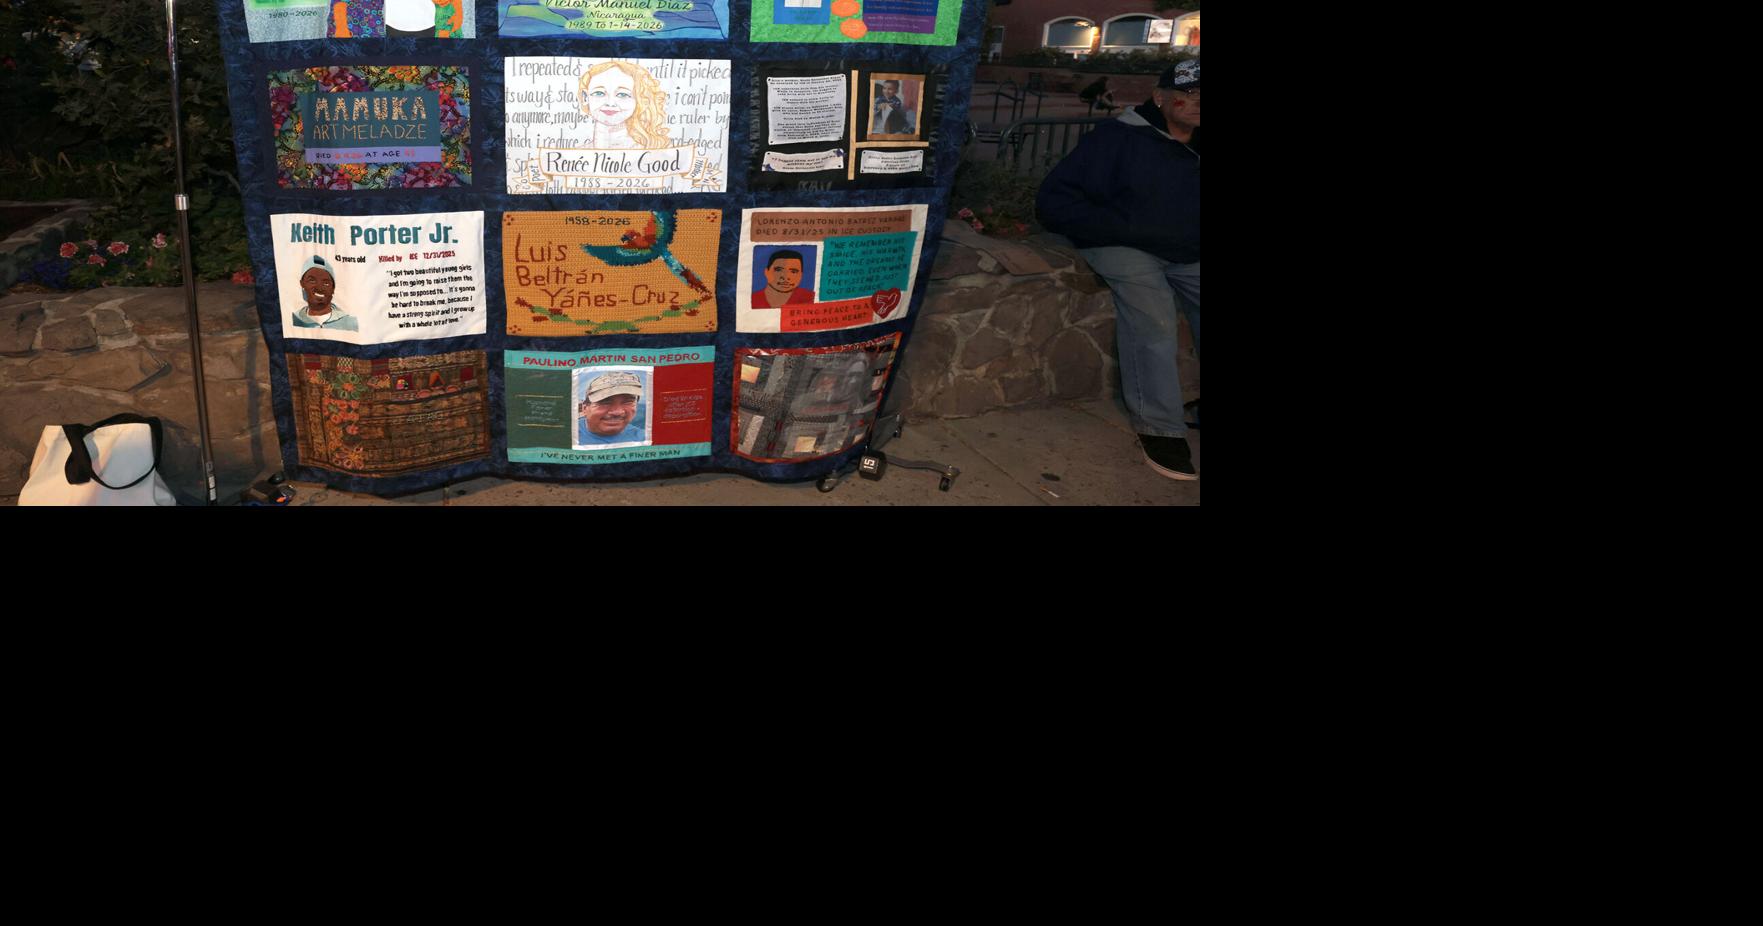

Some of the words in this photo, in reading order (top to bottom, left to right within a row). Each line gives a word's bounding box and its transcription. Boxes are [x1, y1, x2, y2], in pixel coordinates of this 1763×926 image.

[593, 0, 651, 9] Manuel
[587, 11, 646, 21] Nicaragua
[568, 20, 593, 29] 1989
[609, 20, 663, 30] 1-14-2026
[519, 57, 572, 84] repeated
[677, 58, 688, 78] it
[517, 90, 543, 108] way
[314, 96, 427, 122] MAMUKA
[679, 108, 711, 125] ruler
[382, 150, 401, 158] AGE
[546, 151, 590, 173] Renée
[593, 152, 632, 173] Nicole
[637, 149, 680, 174] Good
[616, 178, 650, 188] 2026
[757, 218, 800, 226] LORENZO
[801, 217, 844, 225] ANTONIO
[290, 223, 336, 245] Keith
[350, 223, 422, 246] Porter
[428, 222, 459, 244] Jr.
[756, 228, 782, 236] DIED
[514, 233, 568, 263] Luis
[849, 240, 890, 248] REMEMBER
[342, 256, 355, 264] years
[355, 255, 366, 263] old
[515, 265, 604, 286] Beltrán
[410, 279, 425, 287] going
[540, 284, 680, 308] Yáñes-Cruz
[789, 308, 819, 317] BRING
[790, 316, 839, 327] GENEROUS
[523, 356, 577, 367] PAULINO
[580, 354, 626, 365] MARTIN
[631, 355, 657, 364] SAN
[659, 352, 700, 363] PEDRO
[540, 451, 560, 459] I'VE
[561, 453, 594, 461] NEVER
[629, 451, 657, 459] FINER
[658, 449, 680, 457] MAN
[863, 458, 875, 470] 15
